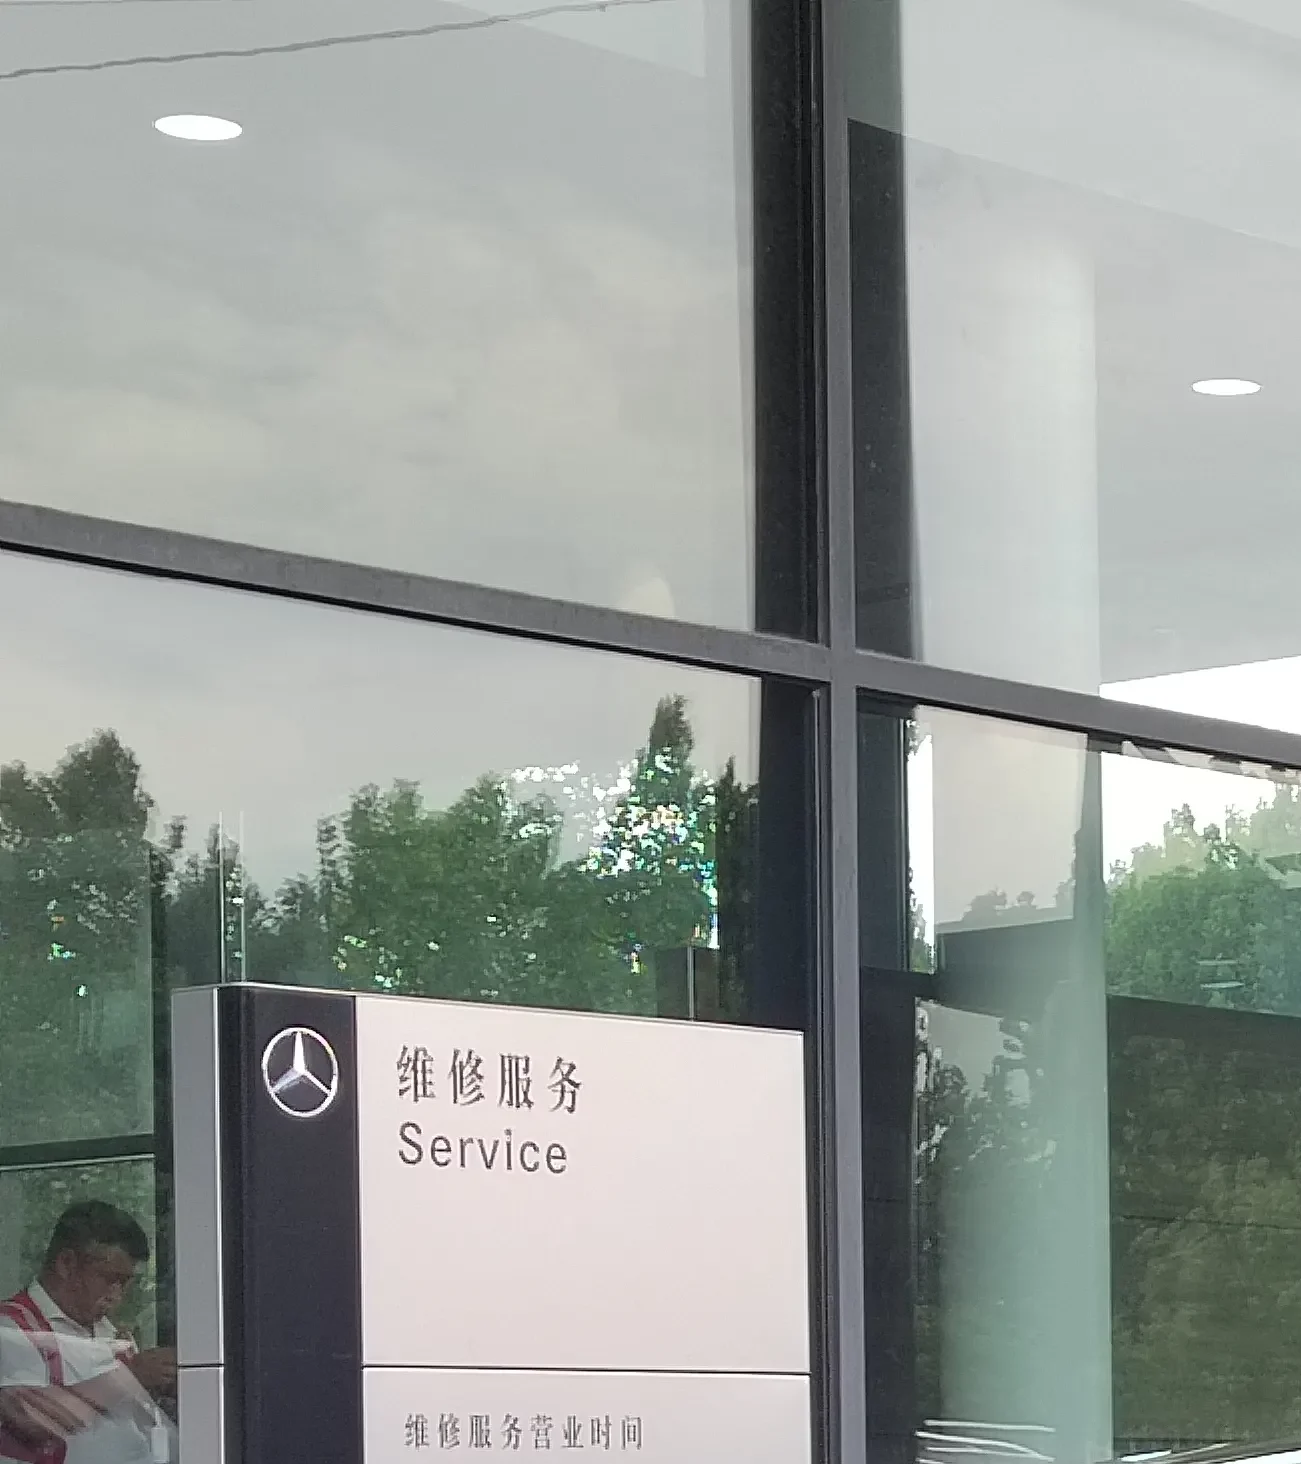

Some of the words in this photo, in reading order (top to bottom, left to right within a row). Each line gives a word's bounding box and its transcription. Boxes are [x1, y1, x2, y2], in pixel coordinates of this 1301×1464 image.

[395, 1044, 583, 1115] 维修服务
[398, 1121, 568, 1175] Service
[403, 1412, 643, 1451] 维修服务营业时间
